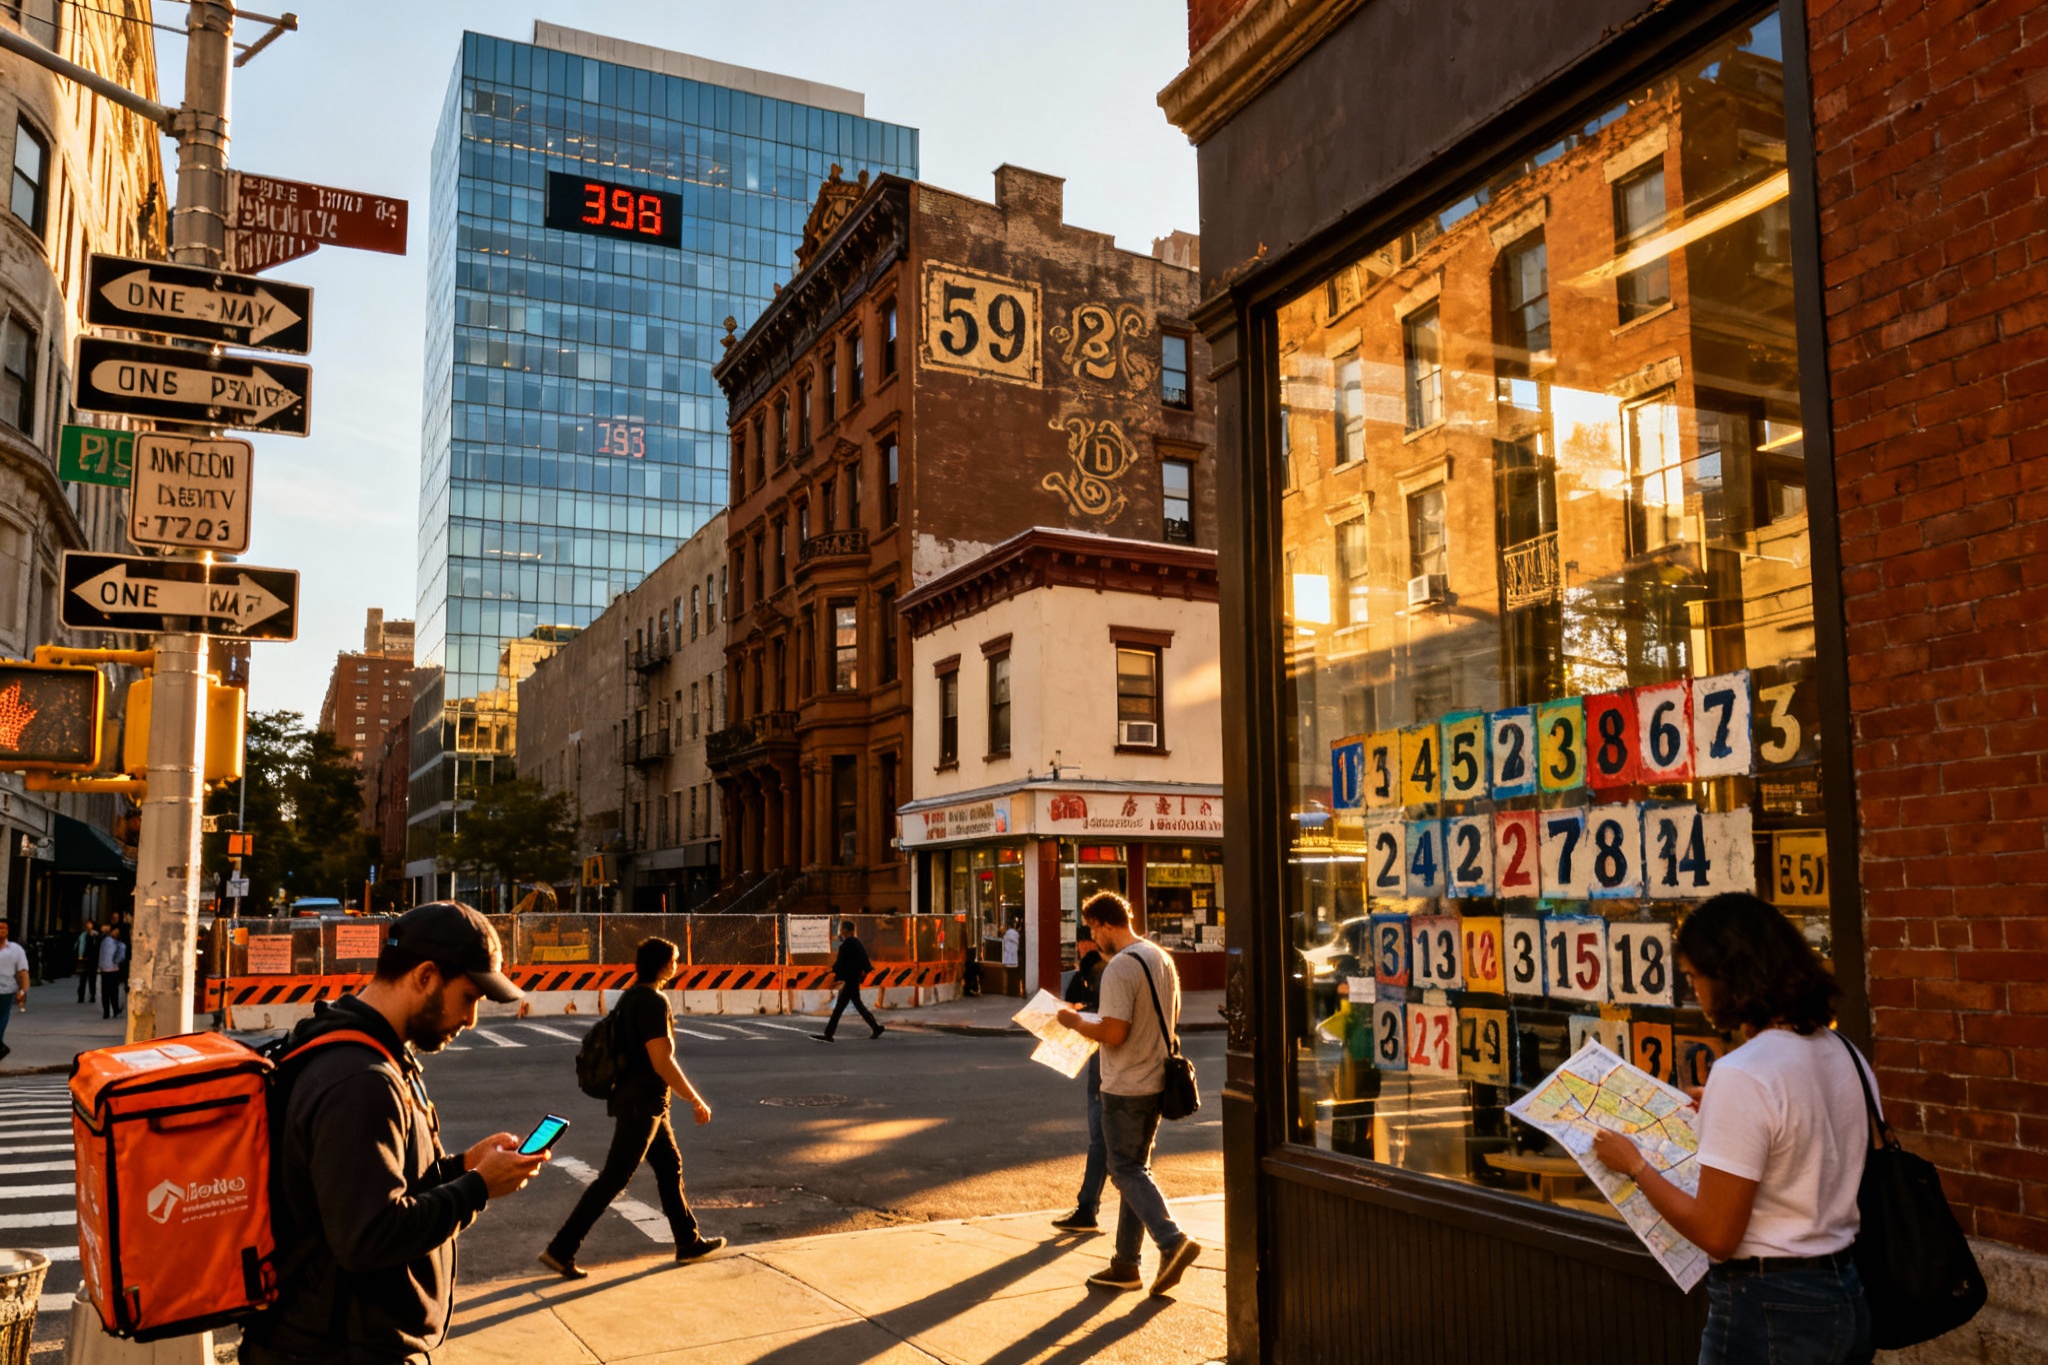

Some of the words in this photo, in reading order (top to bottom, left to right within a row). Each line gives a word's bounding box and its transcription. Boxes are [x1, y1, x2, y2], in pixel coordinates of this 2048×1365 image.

[581, 183, 663, 235] 398
[128, 282, 185, 313] ONE
[940, 280, 1026, 363] 59
[101, 581, 159, 608] ONE
[1410, 737, 1437, 793] 4
[1451, 731, 1479, 791] 5
[1498, 723, 1525, 781] 2
[1550, 717, 1576, 780] 3
[1597, 708, 1628, 775] 8
[1650, 701, 1681, 767] 6
[1703, 688, 1737, 759] 7
[1759, 682, 1801, 764] 3
[1376, 831, 1401, 888] 2
[1411, 830, 1437, 887] 4
[1457, 824, 1484, 882] 2
[1503, 822, 1532, 887] 2
[1548, 817, 1581, 885] 7
[1594, 818, 1627, 888] 8
[1415, 929, 1456, 980] 13
[1514, 931, 1535, 983] 3
[1551, 931, 1600, 991] 15
[1614, 934, 1665, 994] 18
